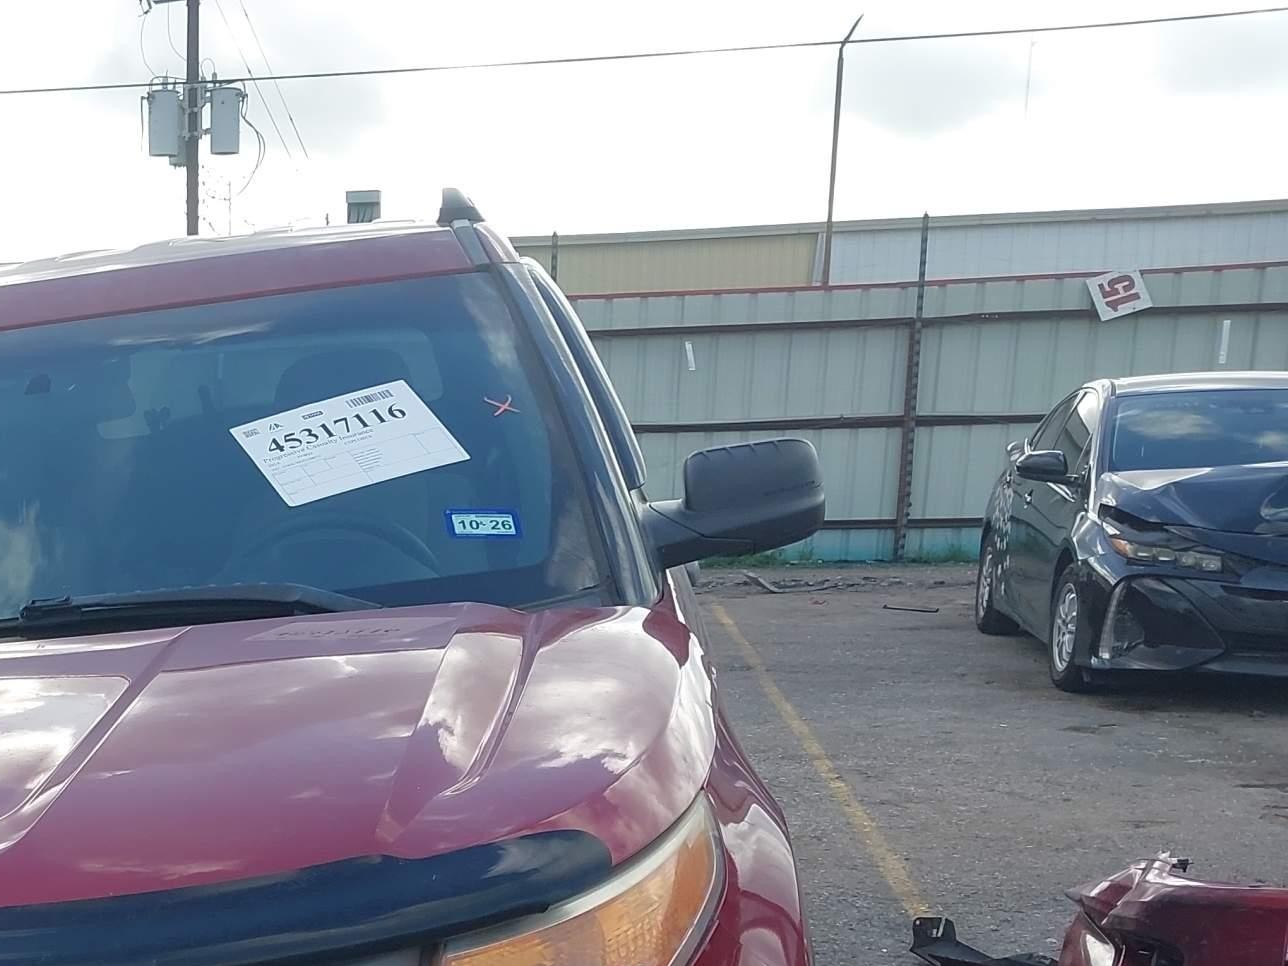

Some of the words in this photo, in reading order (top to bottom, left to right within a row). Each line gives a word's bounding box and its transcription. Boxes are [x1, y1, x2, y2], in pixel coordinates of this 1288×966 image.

[1098, 275, 1141, 312] 15
[268, 401, 407, 453] 45317116
[458, 520, 479, 530] 10
[489, 520, 512, 530] 26
